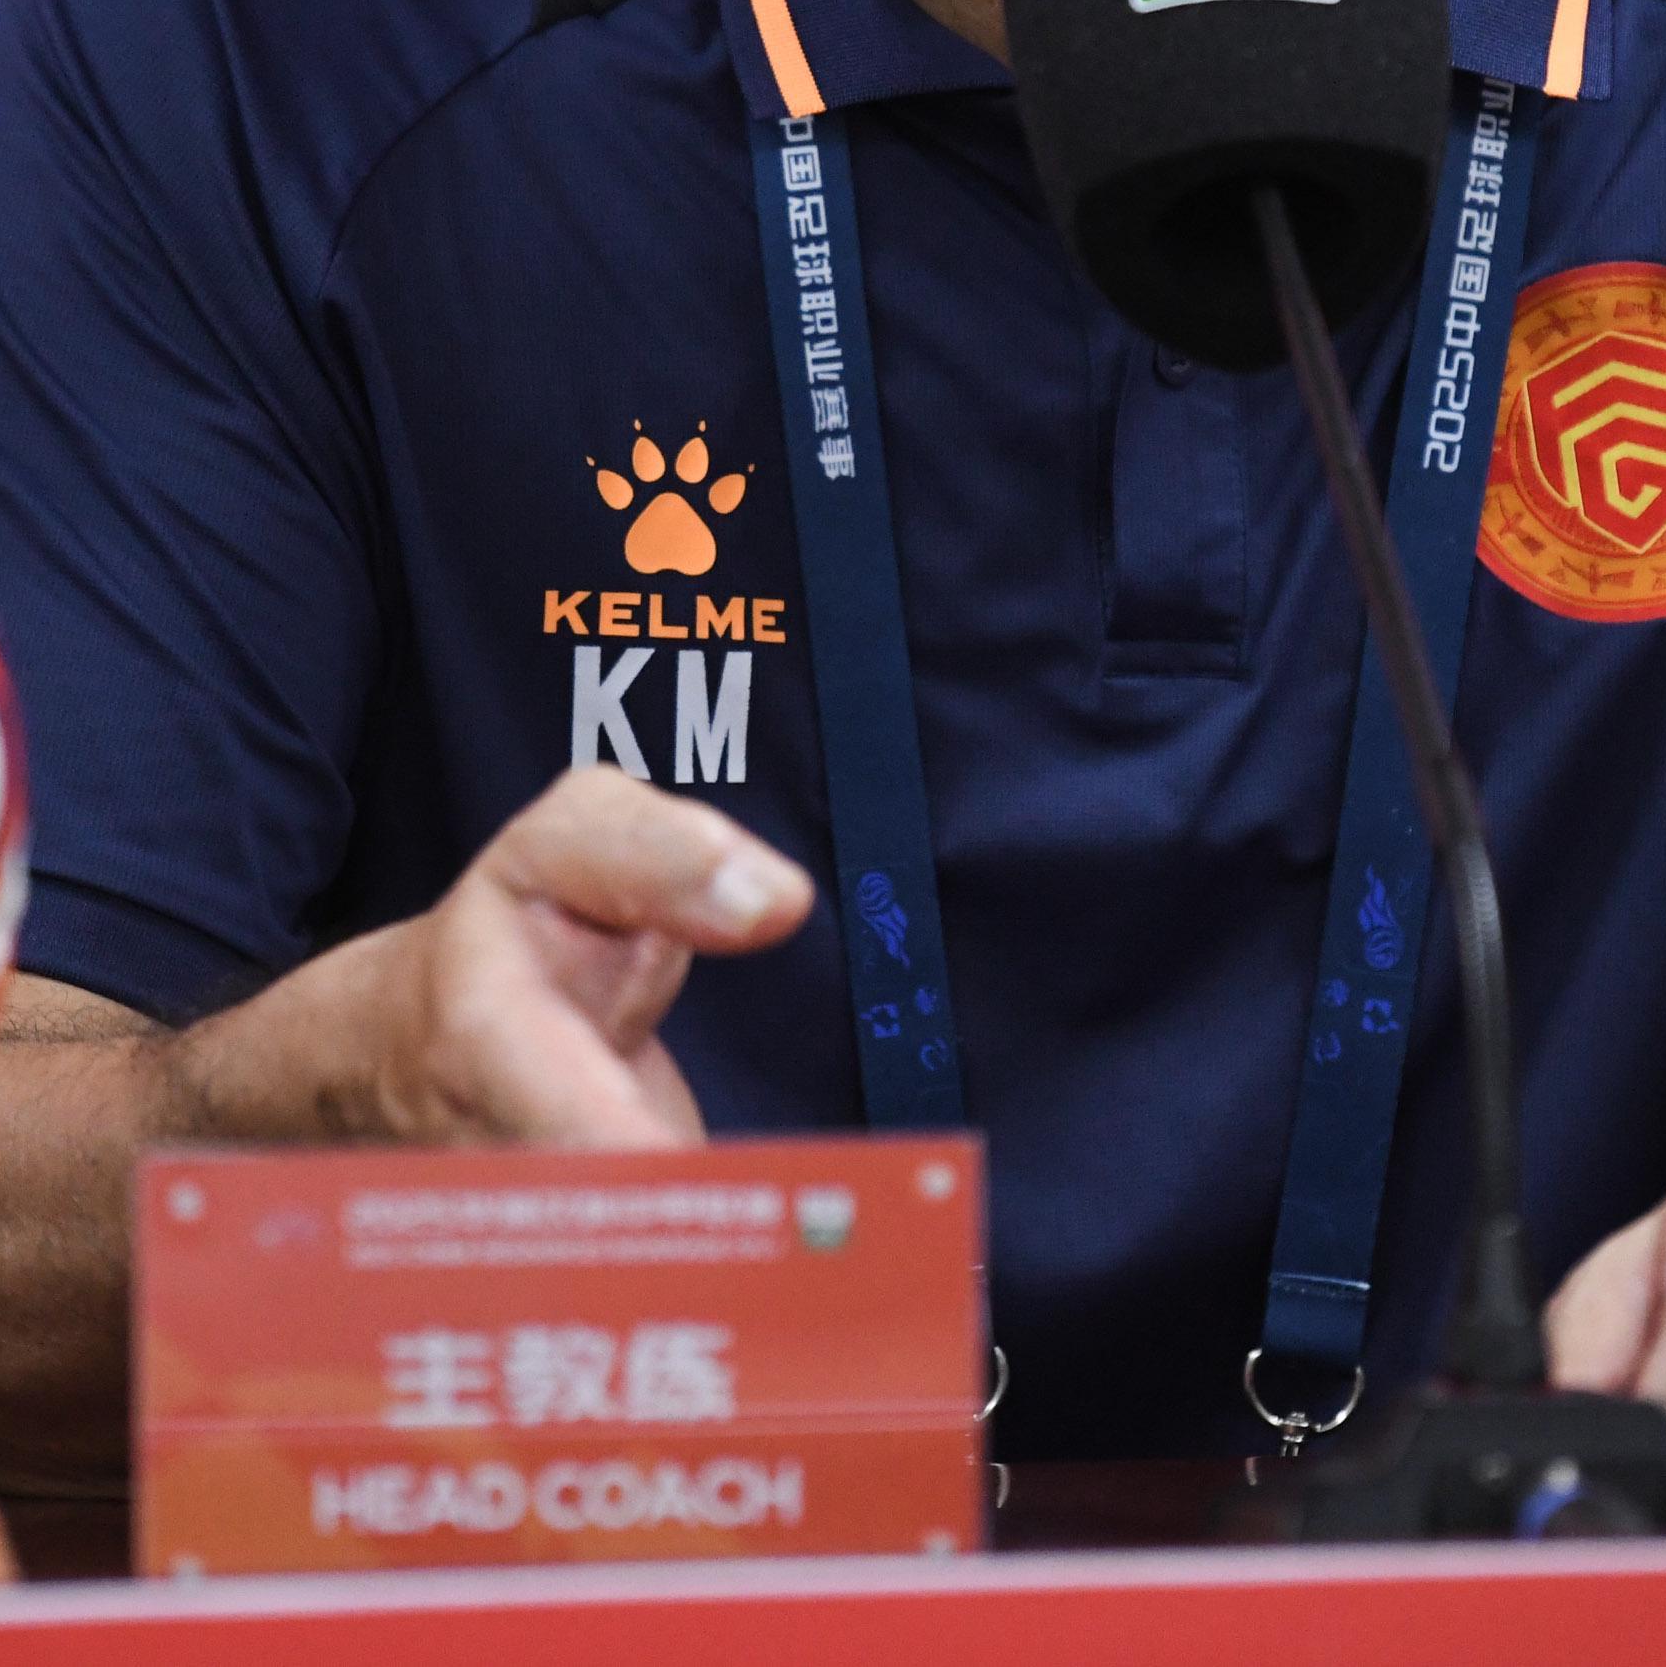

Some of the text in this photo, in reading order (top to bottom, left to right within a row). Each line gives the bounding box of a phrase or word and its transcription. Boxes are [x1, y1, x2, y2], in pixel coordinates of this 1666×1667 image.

[543, 590, 786, 644] KELME
[380, 1319, 739, 1430] 主教练
[311, 1452, 805, 1538] HEAD COACH
